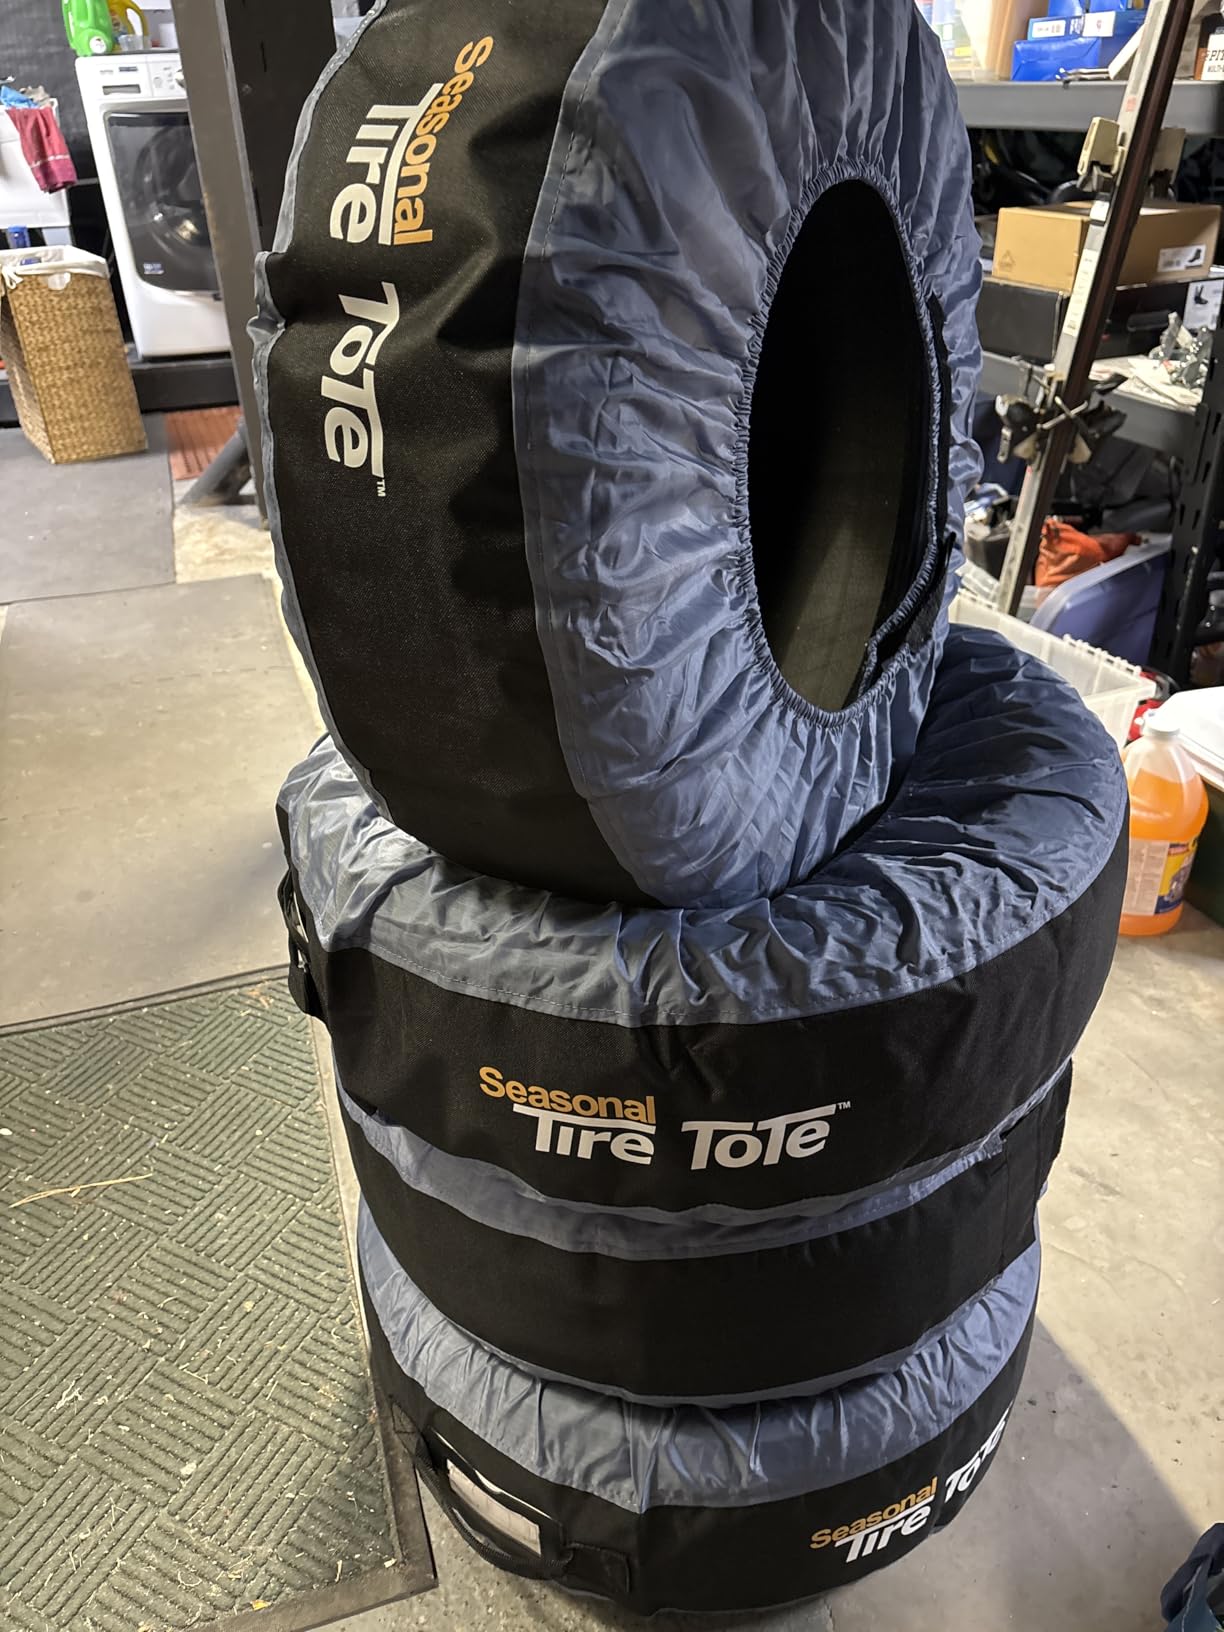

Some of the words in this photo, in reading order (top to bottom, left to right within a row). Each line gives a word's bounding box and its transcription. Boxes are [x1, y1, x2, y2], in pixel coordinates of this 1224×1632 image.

[329, 83, 445, 247] Tire
[393, 35, 494, 247] Seasonal
[478, 1066, 657, 1124] Seasonal
[512, 1102, 658, 1166] Tire
[809, 1475, 938, 1550] Seasonal
[833, 1493, 936, 1564] Tire
